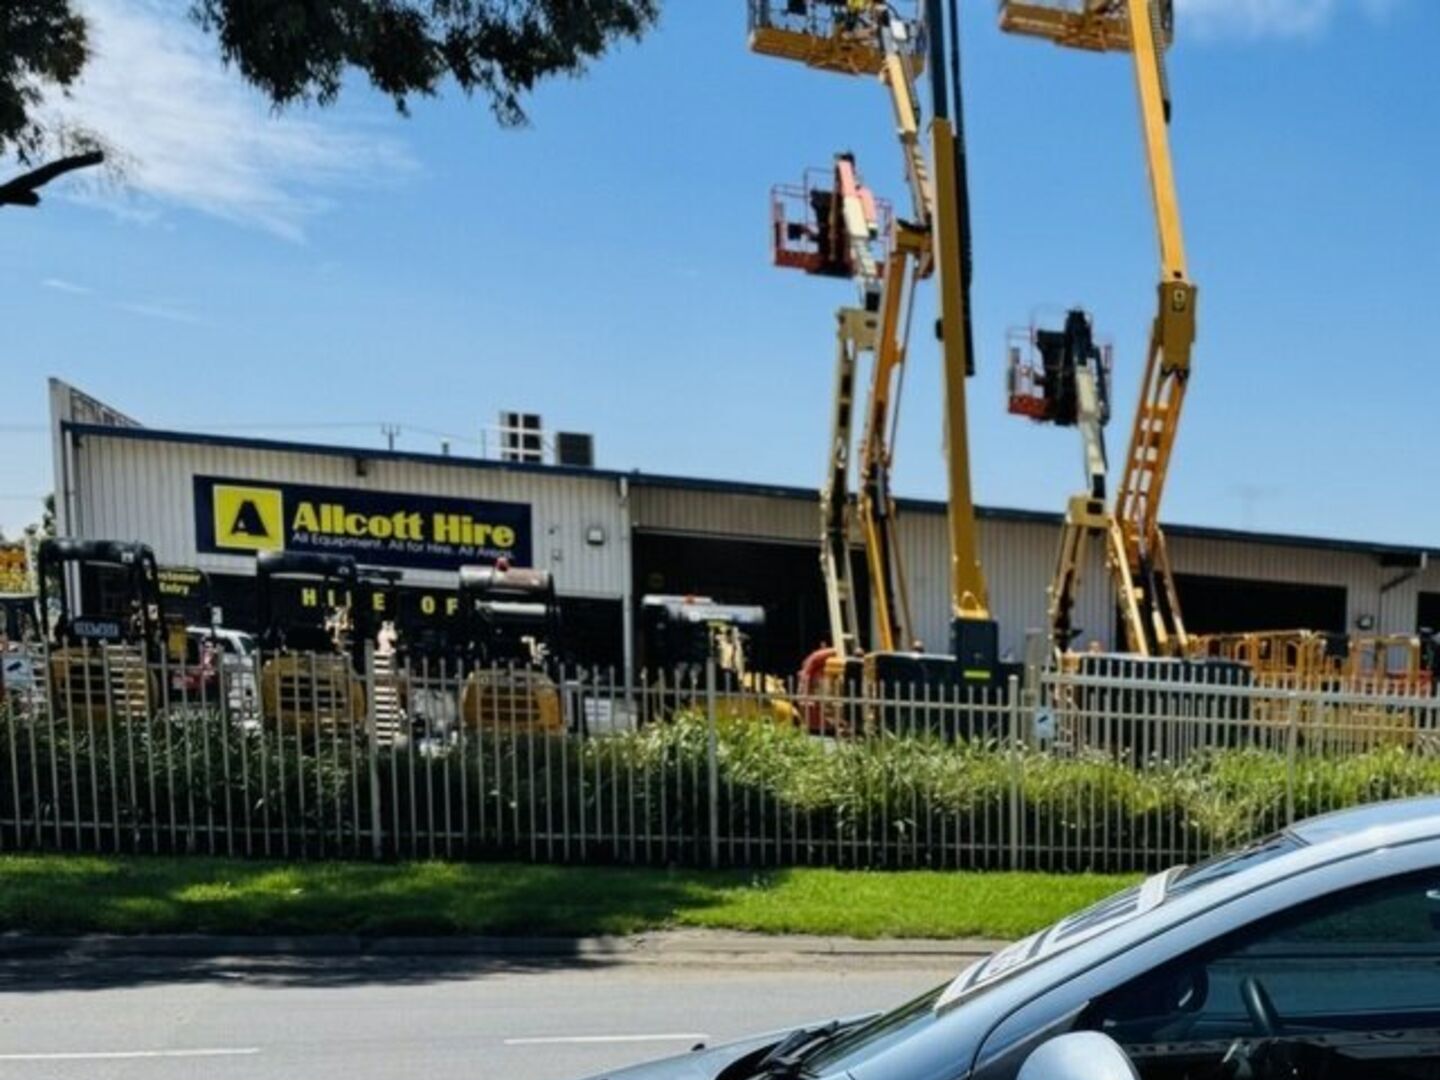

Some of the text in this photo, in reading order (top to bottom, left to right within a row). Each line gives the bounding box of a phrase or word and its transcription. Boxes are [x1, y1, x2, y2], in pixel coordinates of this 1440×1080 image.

[292, 502, 515, 547] Allcott Hire
[293, 533, 308, 543] All
[407, 541, 424, 552] for
